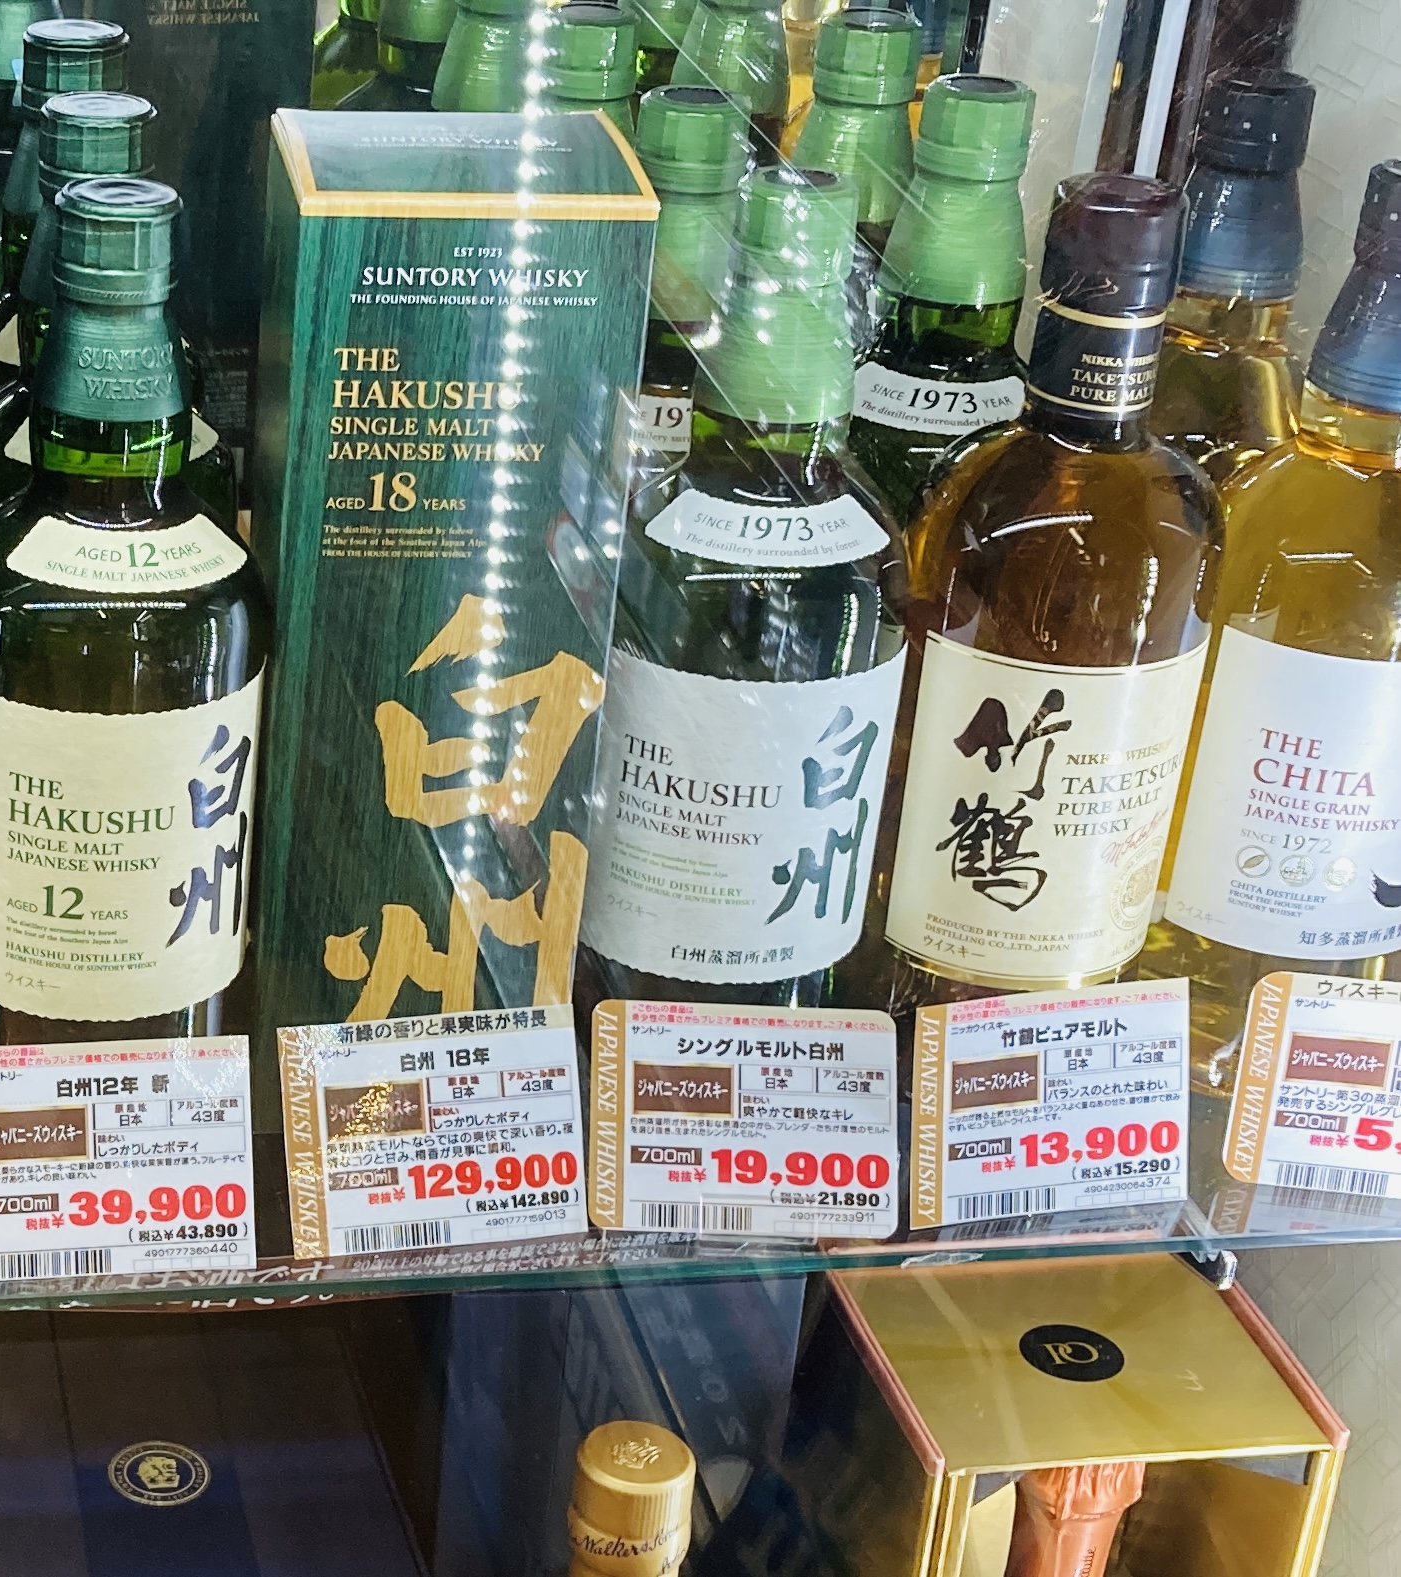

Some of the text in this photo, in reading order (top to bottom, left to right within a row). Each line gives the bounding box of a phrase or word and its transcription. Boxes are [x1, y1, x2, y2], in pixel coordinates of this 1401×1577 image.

[361, 265, 590, 289] SUNTORY WHISKY
[333, 347, 401, 372] THE
[332, 379, 525, 411] HAKUSHU
[870, 381, 1014, 414] SINCE 1973 YEAR
[367, 471, 418, 512] 18
[693, 511, 849, 542] SINCE 1973 YEAR
[74, 541, 202, 568] AGED 12 YEARS
[624, 732, 674, 767] THE
[1260, 726, 1324, 761] THE
[8, 770, 65, 801] THE
[620, 759, 784, 809] HAKUSHU
[1253, 756, 1377, 798] CHITA
[8, 797, 177, 836] HAKUSHU
[324, 593, 606, 1025] 白州
[763, 704, 880, 927] 白州
[935, 688, 1073, 913] 竹鶴
[1055, 785, 1164, 817] PURE MALT
[164, 724, 252, 949] 白州
[1052, 816, 1135, 838] WHISKY
[1240, 827, 1334, 855] SINCE 1972
[6, 847, 161, 874] JAPANESE WHISKY
[41, 883, 86, 922] 12
[922, 935, 986, 960] ウイスキー
[1001, 1017, 1128, 1048] 竹鶴ピュアモルト
[399, 1047, 491, 1073] 白州 18年
[676, 1036, 845, 1062] シングルモルト白州
[56, 1073, 170, 1099] 白州12年 新
[1048, 1078, 1170, 1101] バランスのとれた味わい
[1232, 977, 1283, 1180] JAPANESE WHISKEY
[595, 1004, 618, 1225] JAPANESE WHISKEY
[742, 1104, 855, 1122] 爽やかで軽快なキレ
[638, 1147, 696, 1165] 700ml
[954, 1139, 1007, 1161] 700ml
[1018, 1119, 1181, 1169] 13,900
[407, 1150, 578, 1201] 129,900
[710, 1148, 891, 1189] 19,900
[68, 1182, 247, 1227] 39,900
